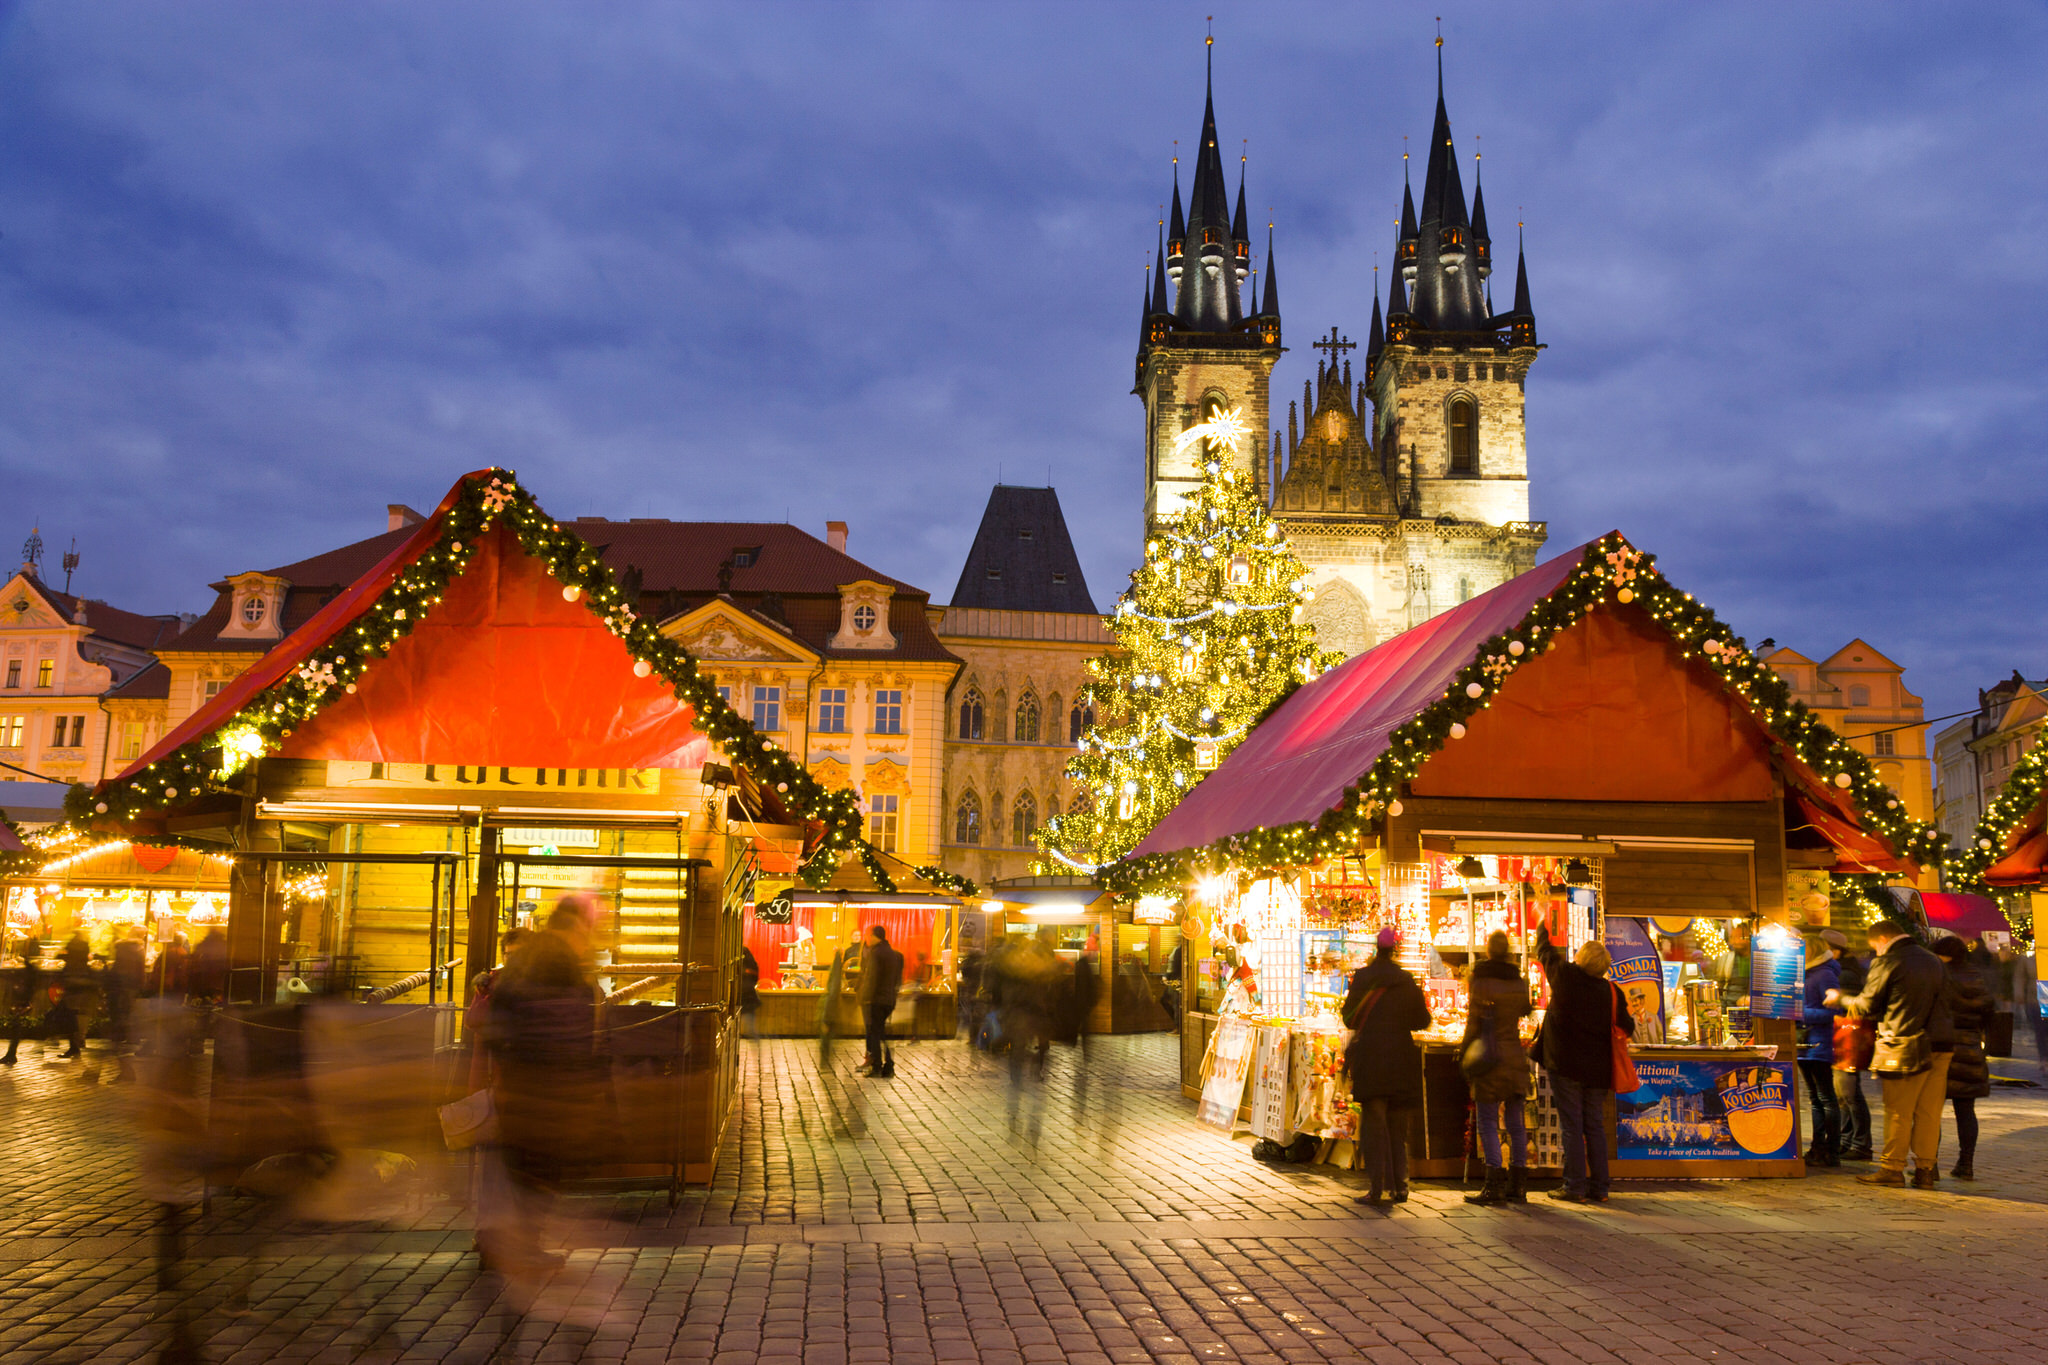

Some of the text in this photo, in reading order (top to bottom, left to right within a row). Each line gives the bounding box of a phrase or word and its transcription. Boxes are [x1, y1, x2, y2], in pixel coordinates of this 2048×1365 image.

[1607, 959, 1657, 978] OLONADA
[1634, 1064, 1680, 1076] ditional
[1722, 1087, 1782, 1110] KOLONADA
[1648, 1148, 1662, 1156] Take
[1669, 1149, 1684, 1157] piece
[1685, 1148, 1693, 1157] of
[1693, 1148, 1711, 1156] Czech
[1712, 1148, 1740, 1156] tradition
